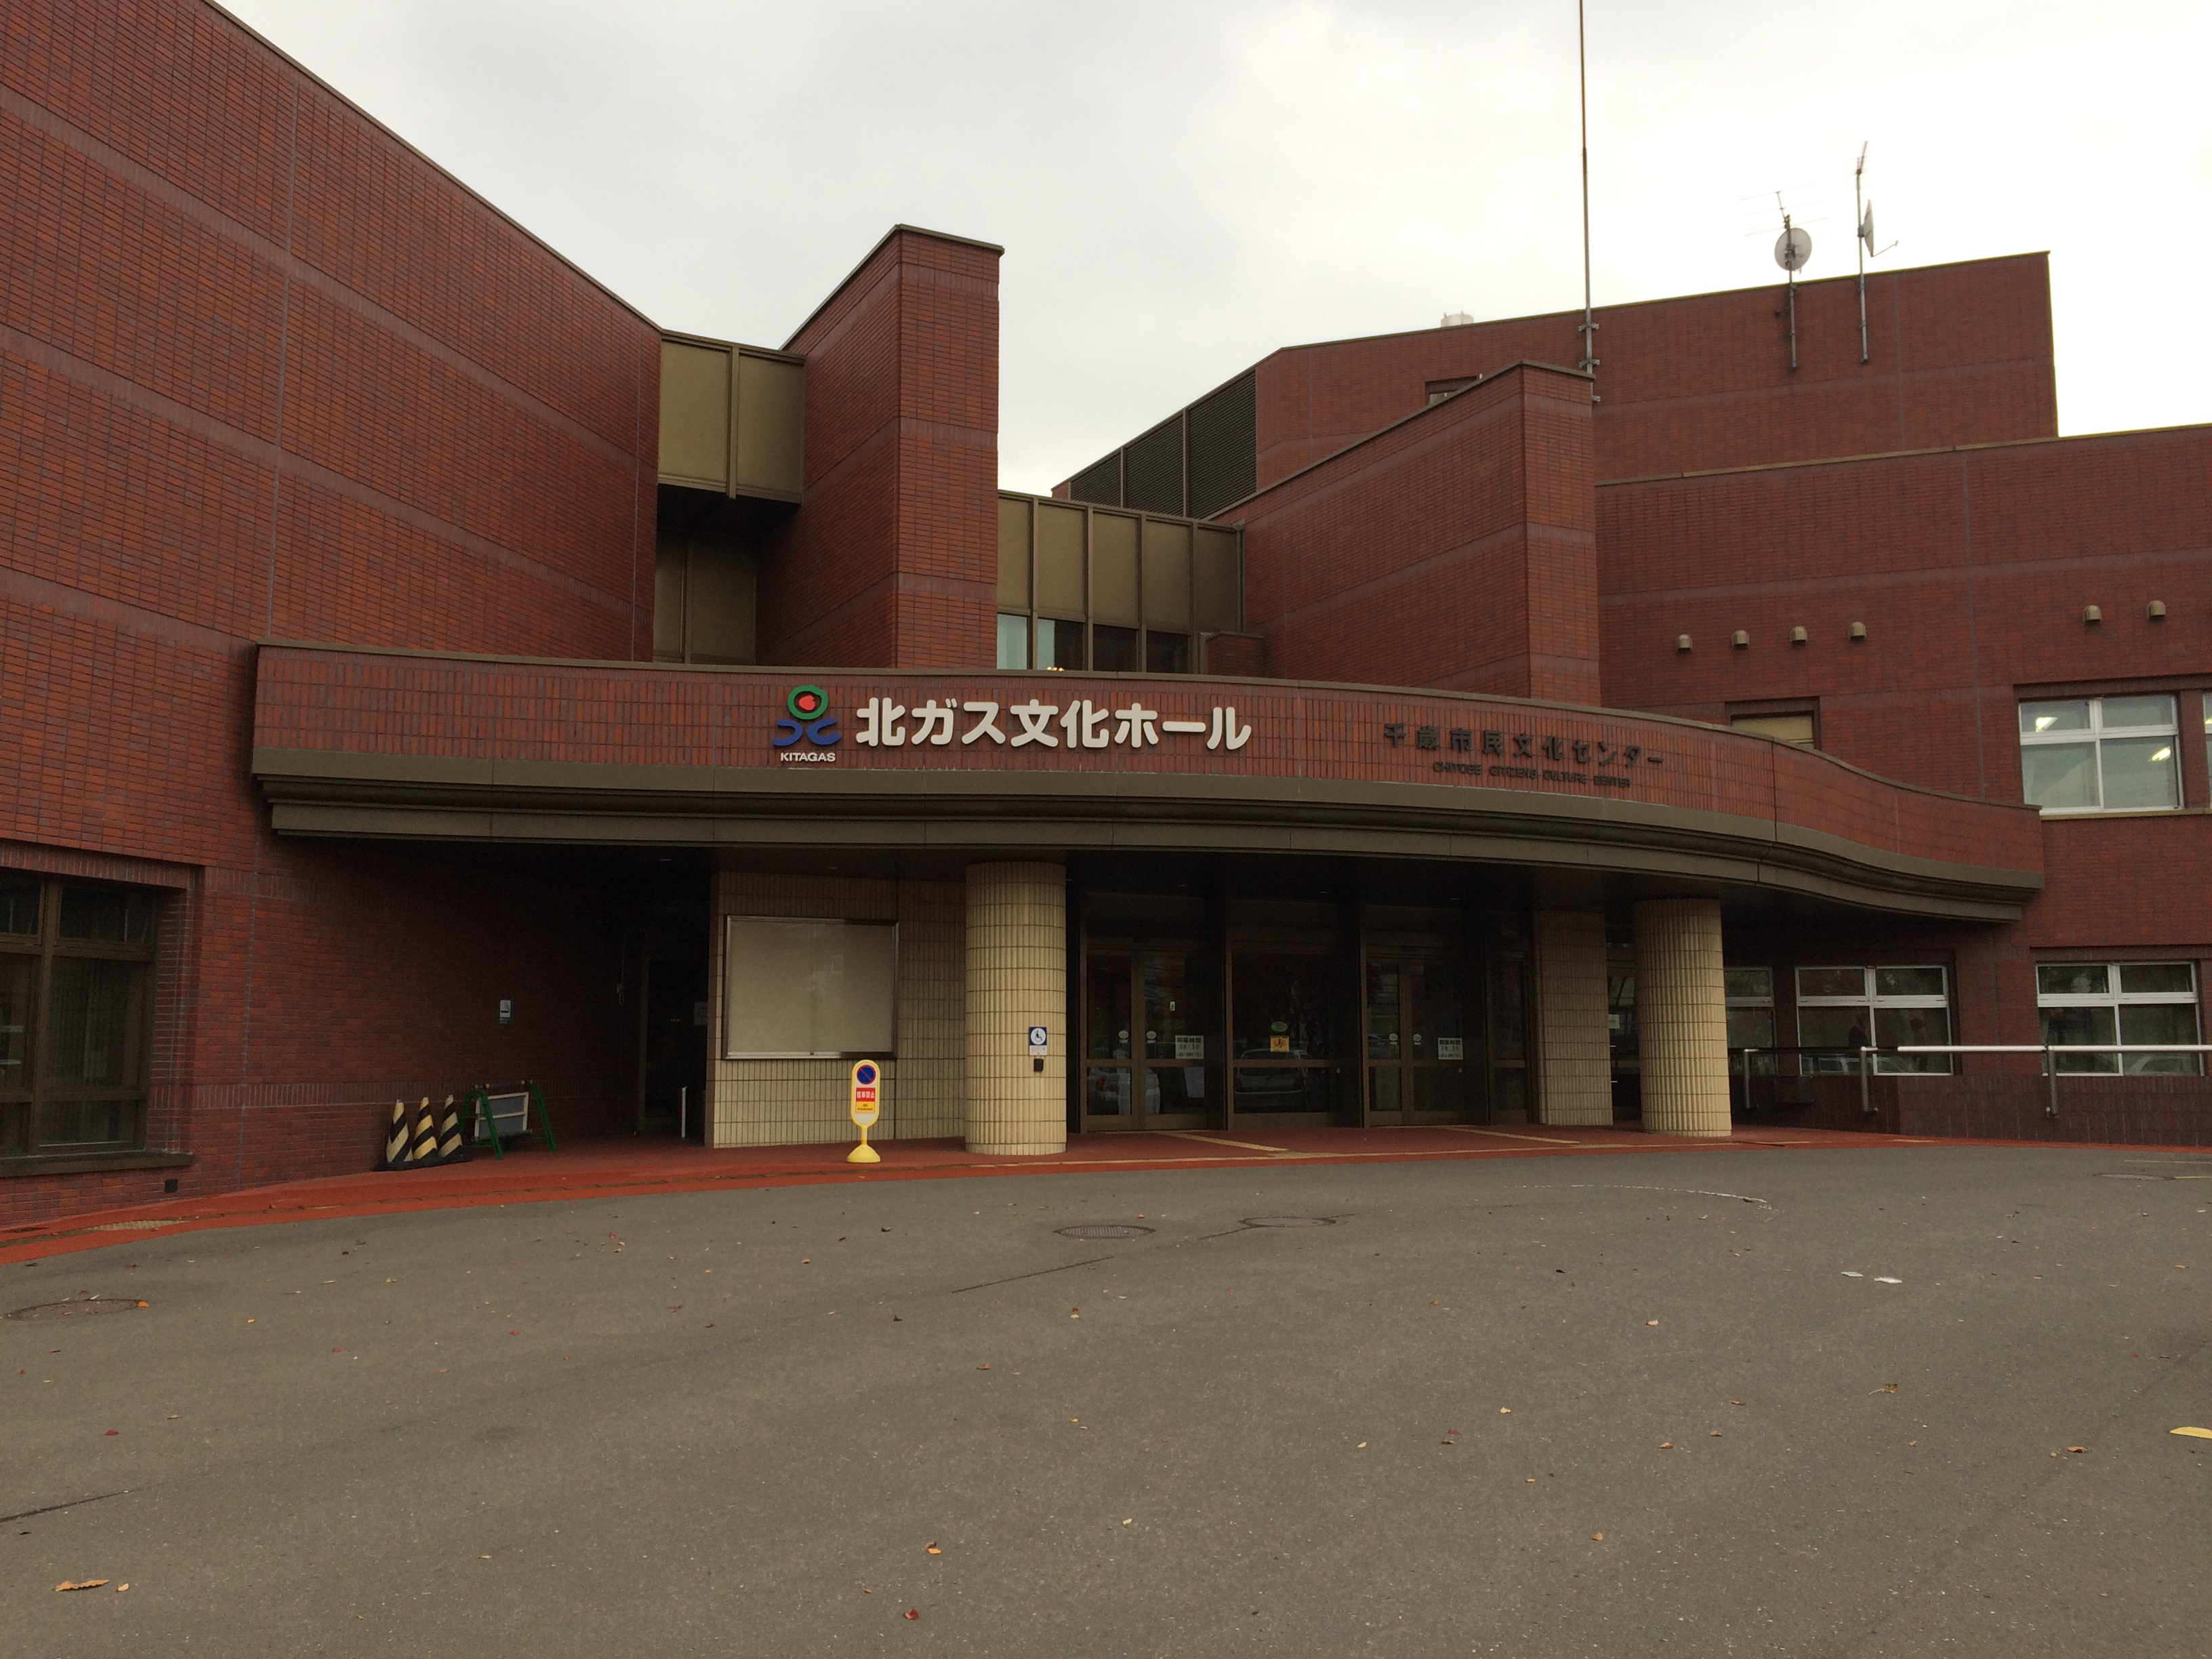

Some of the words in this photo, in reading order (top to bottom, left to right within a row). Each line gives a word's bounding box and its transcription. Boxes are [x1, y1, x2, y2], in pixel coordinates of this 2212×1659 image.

[856, 697, 1252, 750] 北ガス文化ホール
[1384, 722, 1664, 768] 千歳市民文化センター
[780, 752, 836, 762] KITAGAS
